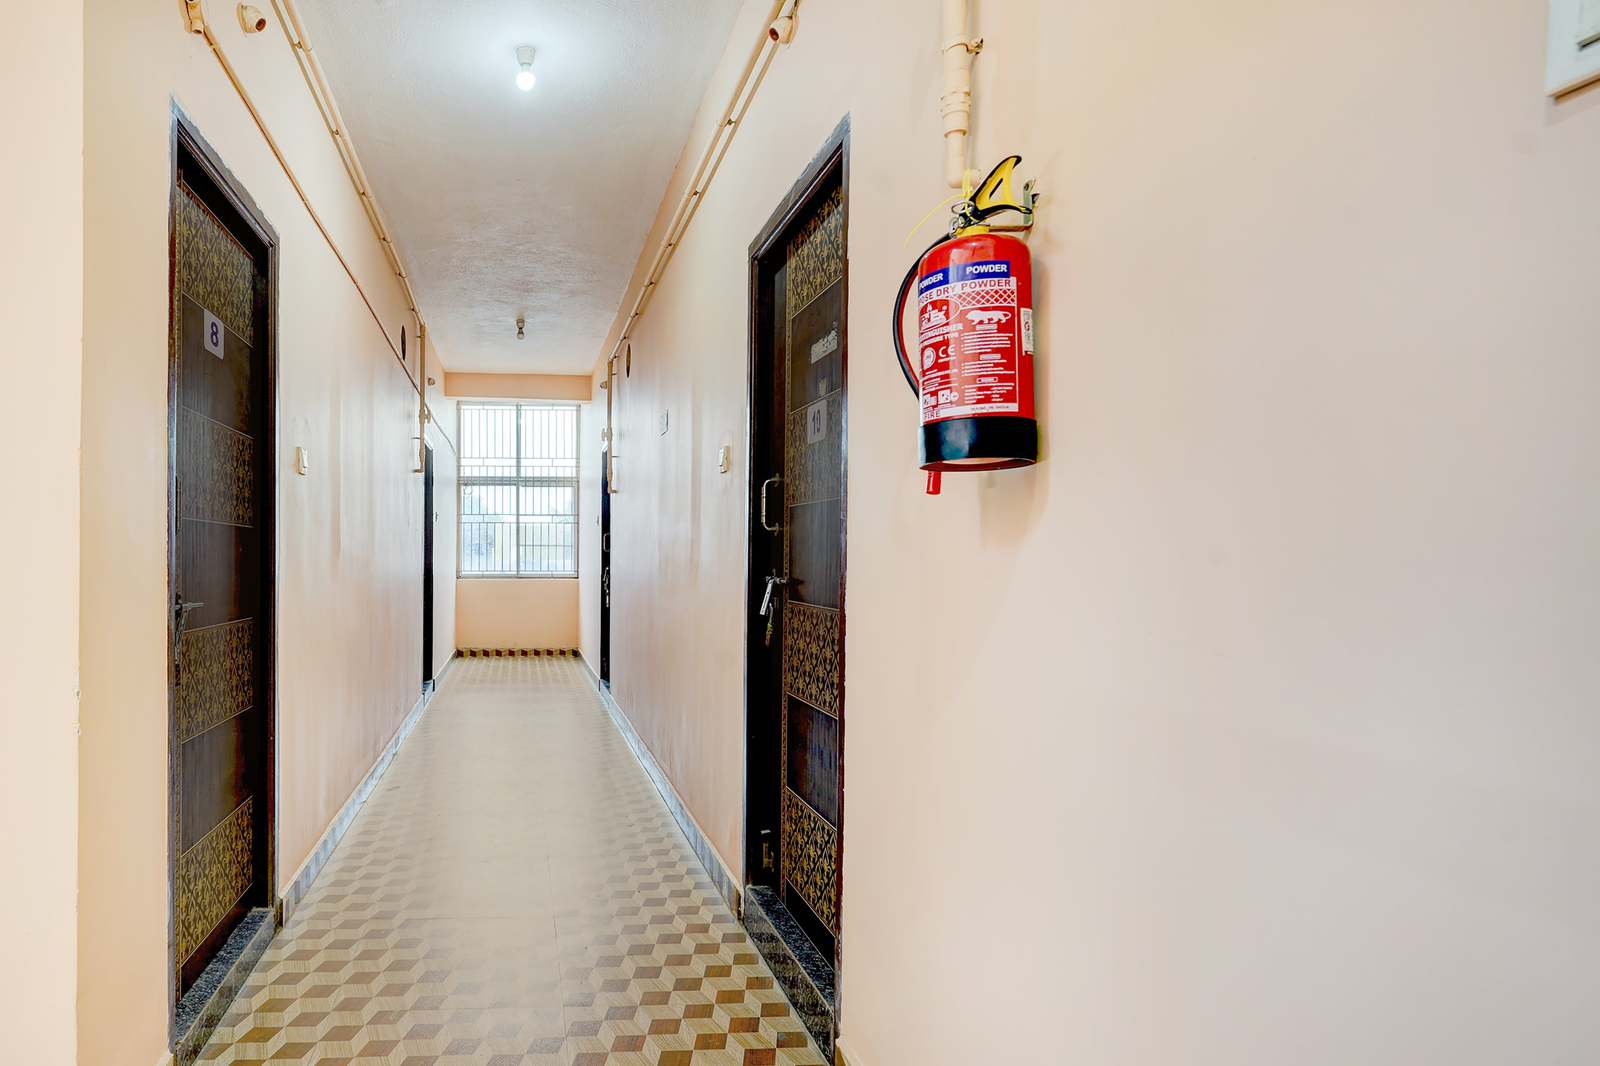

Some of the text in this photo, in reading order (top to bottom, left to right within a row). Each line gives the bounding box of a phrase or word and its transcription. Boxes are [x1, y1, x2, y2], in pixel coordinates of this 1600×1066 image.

[966, 264, 1008, 274] POWDER
[919, 273, 944, 290] POWDER
[936, 284, 956, 297] DRY
[962, 279, 1011, 290] POWDER
[210, 322, 219, 348] 8
[812, 408, 820, 435] 10
[924, 410, 941, 420] FIRE
